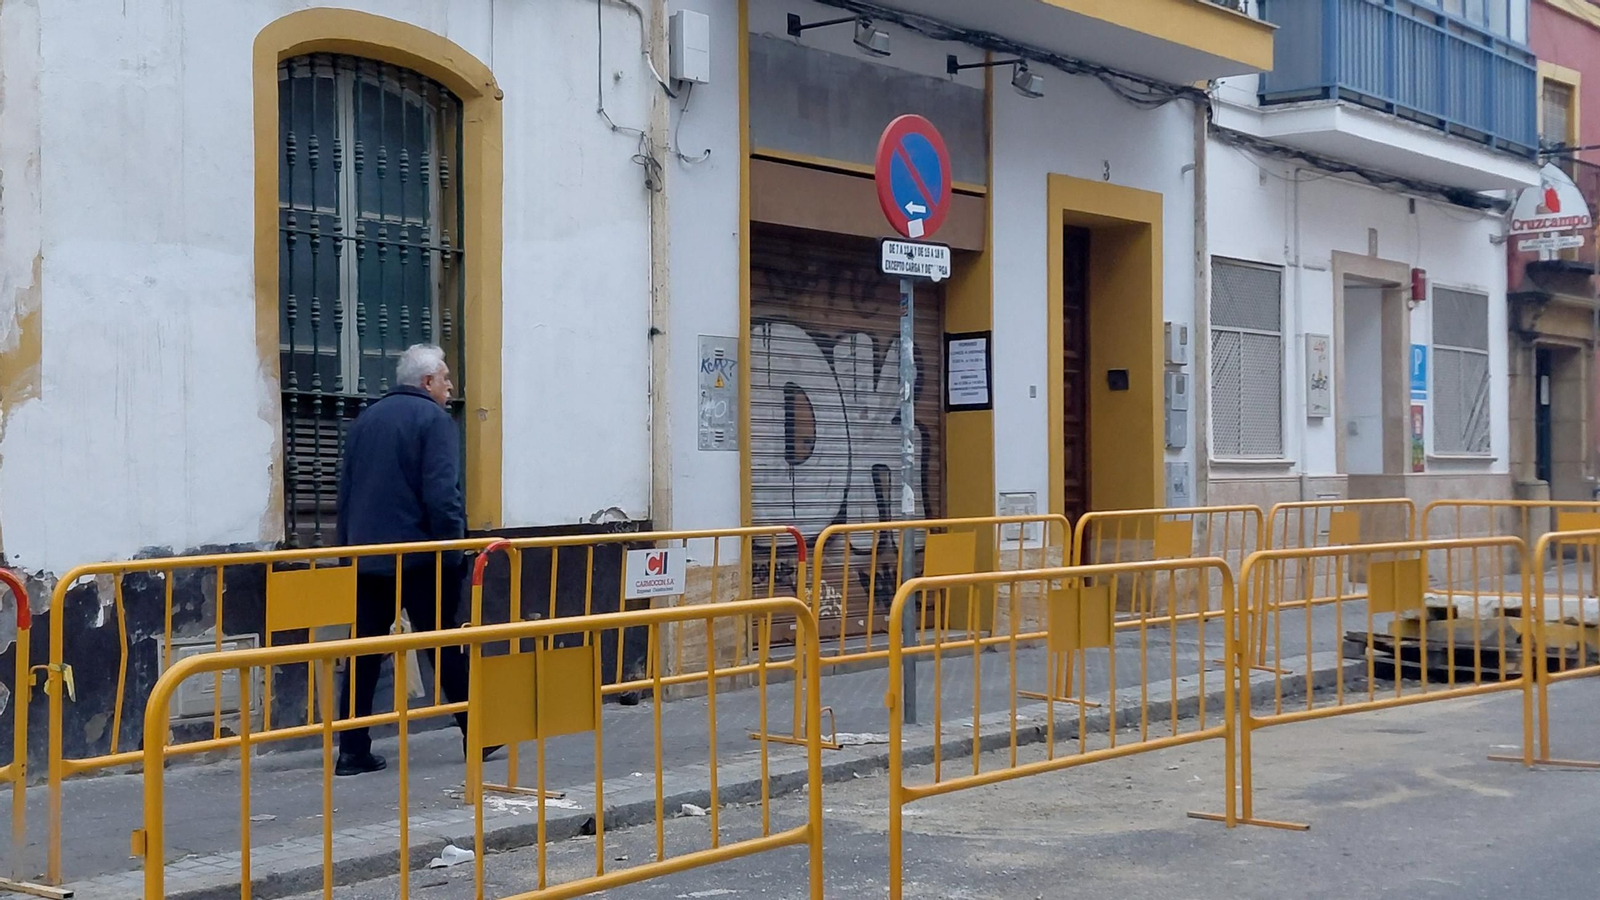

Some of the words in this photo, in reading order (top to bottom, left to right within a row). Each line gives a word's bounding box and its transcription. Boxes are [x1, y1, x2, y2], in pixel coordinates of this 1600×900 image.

[1103, 160, 1110, 181] 3
[1512, 215, 1589, 231] Cruzcampo
[889, 243, 896, 254] DE
[899, 244, 903, 254] A
[918, 246, 924, 257] DE
[931, 248, 934, 258] A
[885, 260, 905, 271] EXCEPTO
[905, 262, 920, 273] CARGA
[920, 263, 924, 273] Y
[1414, 349, 1423, 375] P
